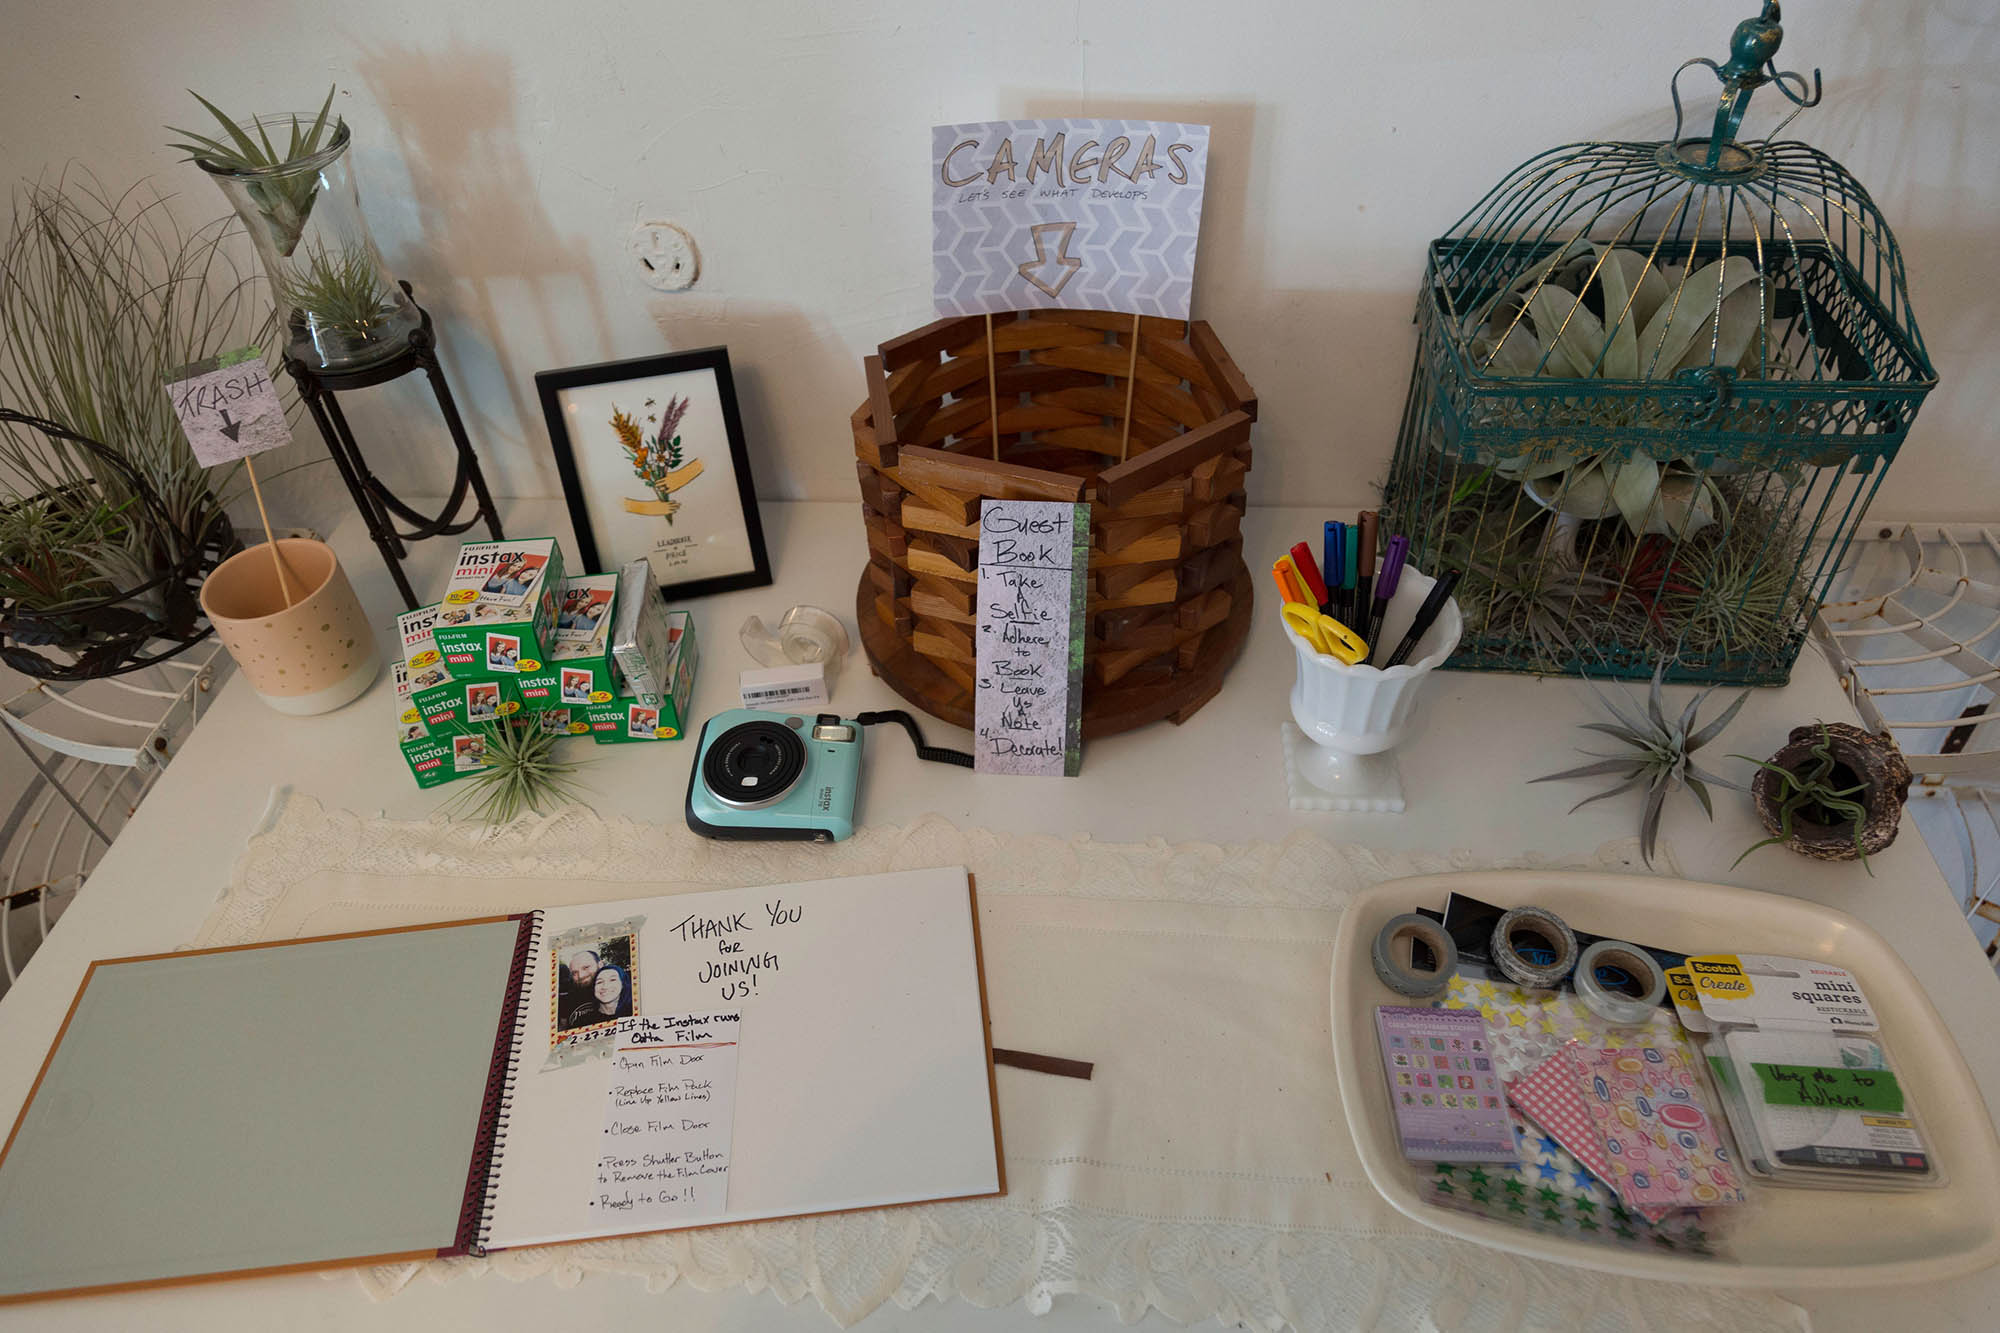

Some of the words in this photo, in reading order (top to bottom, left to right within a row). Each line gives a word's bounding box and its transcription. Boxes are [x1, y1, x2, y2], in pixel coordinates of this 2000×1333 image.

[941, 132, 1194, 188] CAMERAS
[1002, 189, 1027, 199] SEE
[1039, 188, 1077, 199] WHAT
[178, 373, 268, 418] TRASH
[983, 506, 1069, 535] Guest
[460, 551, 525, 566] instax
[992, 539, 1055, 564] Book
[456, 565, 495, 577] mini
[996, 571, 1043, 589] Take
[990, 599, 1054, 620] Selfie
[1002, 622, 1050, 644] Adhere
[441, 642, 483, 653] instax
[1014, 647, 1031, 656] to
[449, 654, 473, 663] mini
[991, 661, 1043, 678] Book
[517, 676, 557, 688] instax
[1000, 682, 1047, 695] Leave
[525, 689, 549, 697] mini
[422, 697, 463, 715] instax
[431, 711, 456, 724] mini
[588, 712, 625, 722] instax
[1001, 708, 1041, 730] Note
[409, 746, 450, 763] instax
[990, 737, 1063, 757] Decorate!
[417, 759, 441, 771] mini
[822, 785, 833, 811] instax
[670, 912, 753, 942] THANK
[766, 900, 802, 927] YOU
[698, 952, 779, 984] JOINING
[1694, 962, 1739, 975] Scotch
[721, 974, 759, 1000] US!
[1700, 976, 1747, 991] Create
[1814, 980, 1856, 992] mini
[1792, 991, 1862, 1004] squares
[617, 1018, 636, 1033] If
[638, 1018, 660, 1031] the
[664, 1014, 710, 1029] Instax
[714, 1012, 740, 1022] runs
[676, 1030, 713, 1042] Film
[620, 1056, 645, 1072] Open
[650, 1054, 672, 1067] Film
[680, 1054, 704, 1066] Door
[615, 1086, 654, 1098] Replace
[658, 1082, 680, 1093] Film
[682, 1078, 712, 1090] Pack
[611, 1121, 642, 1136] Close
[648, 1120, 674, 1133] Film
[682, 1119, 711, 1131] Door
[603, 1155, 637, 1169] Press
[643, 1153, 680, 1167] Shutter
[684, 1148, 724, 1164] Button
[597, 1174, 608, 1184] to
[612, 1171, 654, 1183] Remove
[657, 1169, 676, 1180] the
[677, 1166, 699, 1177] Film
[699, 1165, 729, 1175] Cover
[600, 1190, 634, 1210] Ready
[638, 1192, 652, 1203] to
